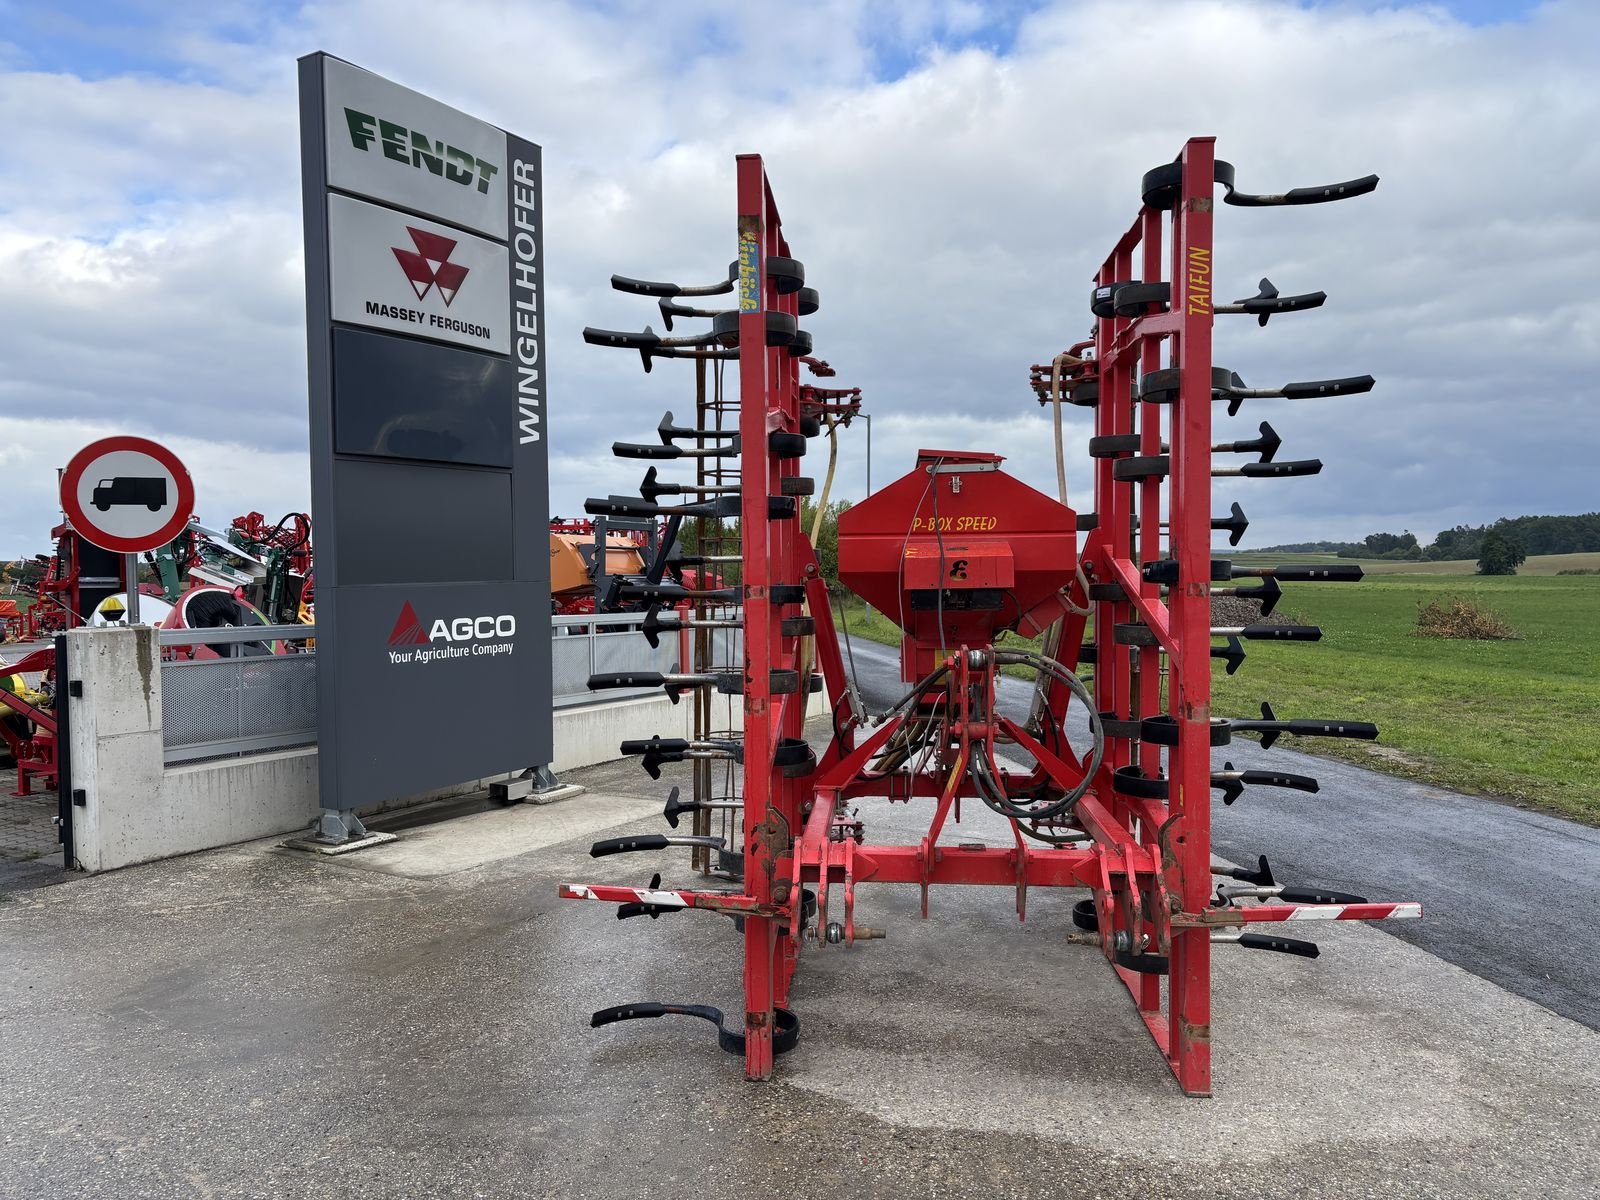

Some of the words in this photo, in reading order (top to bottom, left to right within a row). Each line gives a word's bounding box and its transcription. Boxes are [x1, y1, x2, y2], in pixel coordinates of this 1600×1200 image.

[343, 107, 499, 195] FENDT
[1189, 246, 1210, 315] TAIFUN
[365, 300, 426, 324] MASSEY
[429, 314, 491, 340] FERGUSON
[513, 158, 541, 445] WINGELHOFER
[912, 516, 953, 532] P-BOX
[956, 516, 997, 531] SPEED
[428, 614, 516, 642] AGCO
[388, 650, 413, 664] Your
[414, 646, 470, 664] Agriculture
[472, 642, 514, 657] Company
